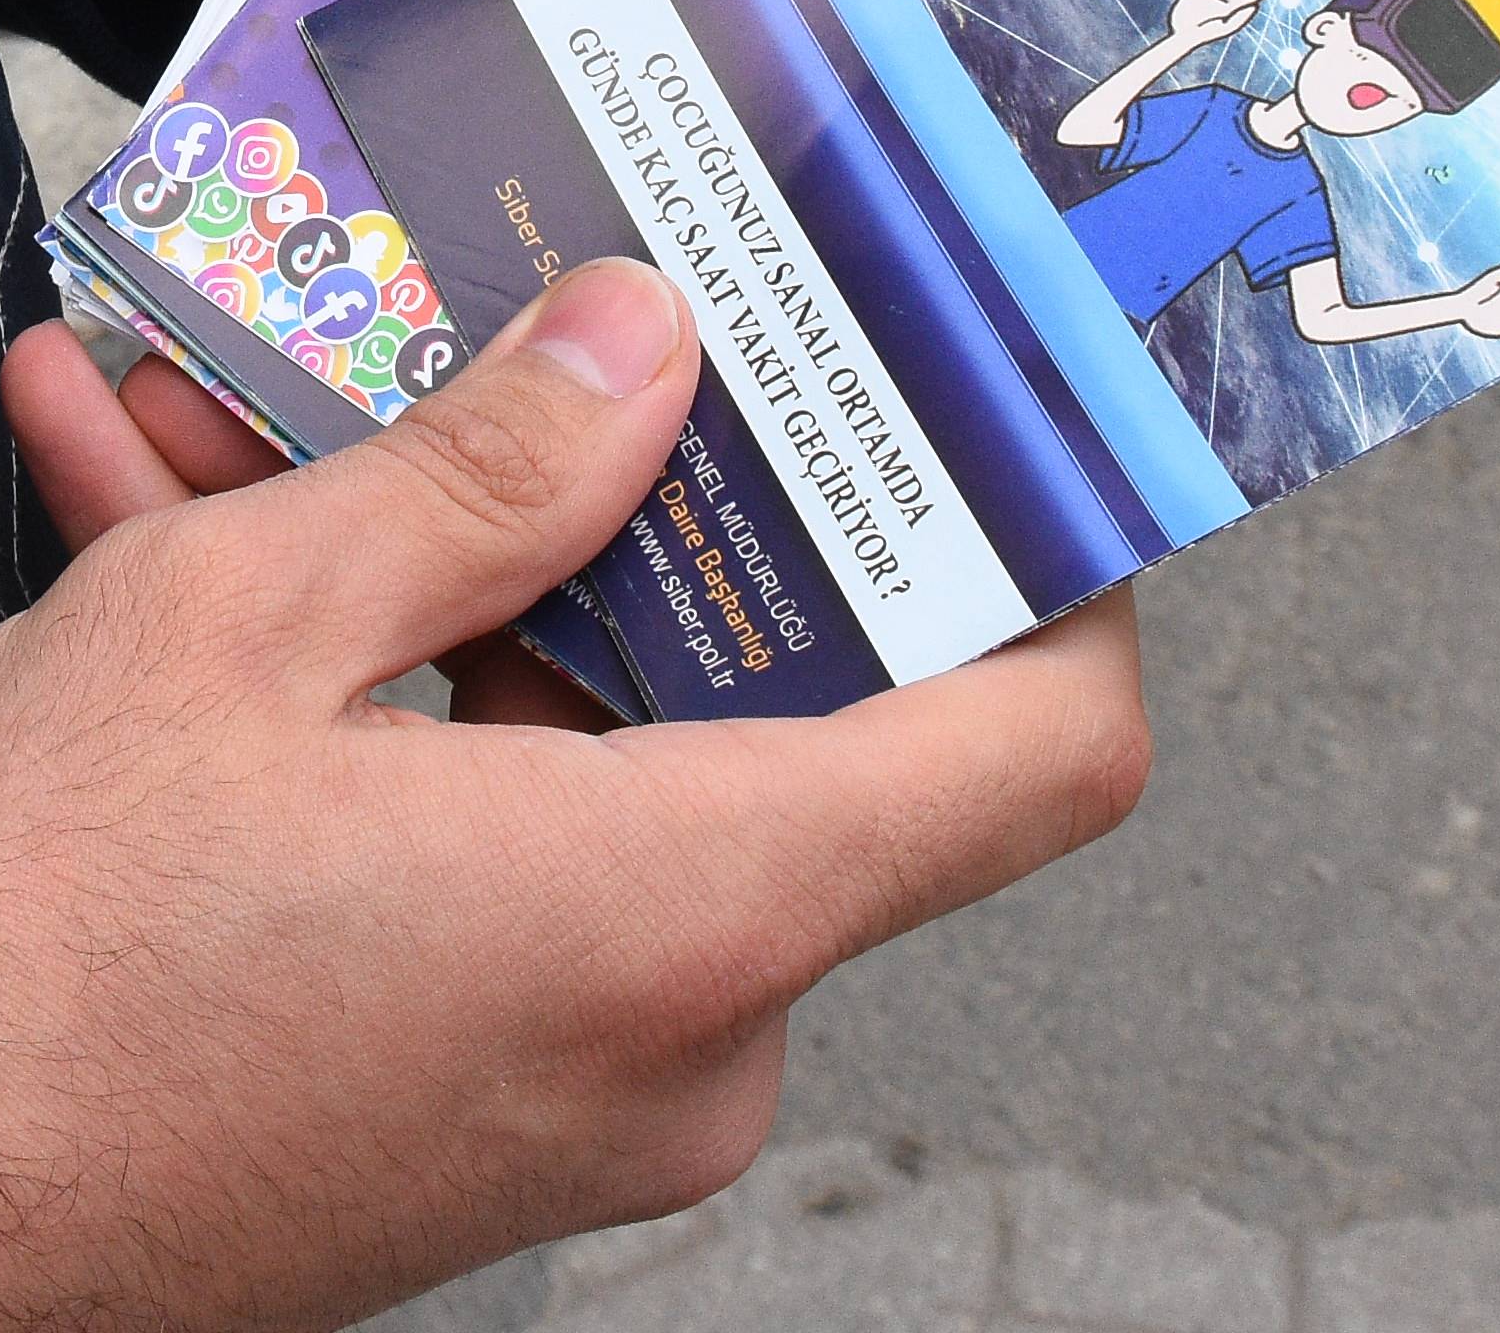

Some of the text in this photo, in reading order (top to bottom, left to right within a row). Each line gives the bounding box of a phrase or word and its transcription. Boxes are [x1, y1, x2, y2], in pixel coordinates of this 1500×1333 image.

[495, 177, 544, 247] Siber
[568, 27, 653, 151] GÜNDE
[632, 146, 695, 225] KAÇ
[675, 222, 745, 308] SAAT
[727, 305, 803, 408] VAKİT
[784, 409, 900, 587] GEÇİRİYOR
[637, 52, 935, 530] ÇOCUĞUNUZ SANAL ORTAMDA
[629, 511, 739, 691] www.siber.pol.tr
[657, 479, 775, 675] Daire Başkanlığı
[677, 419, 817, 654] GENEL MÜDÜRLÜĞÜ
